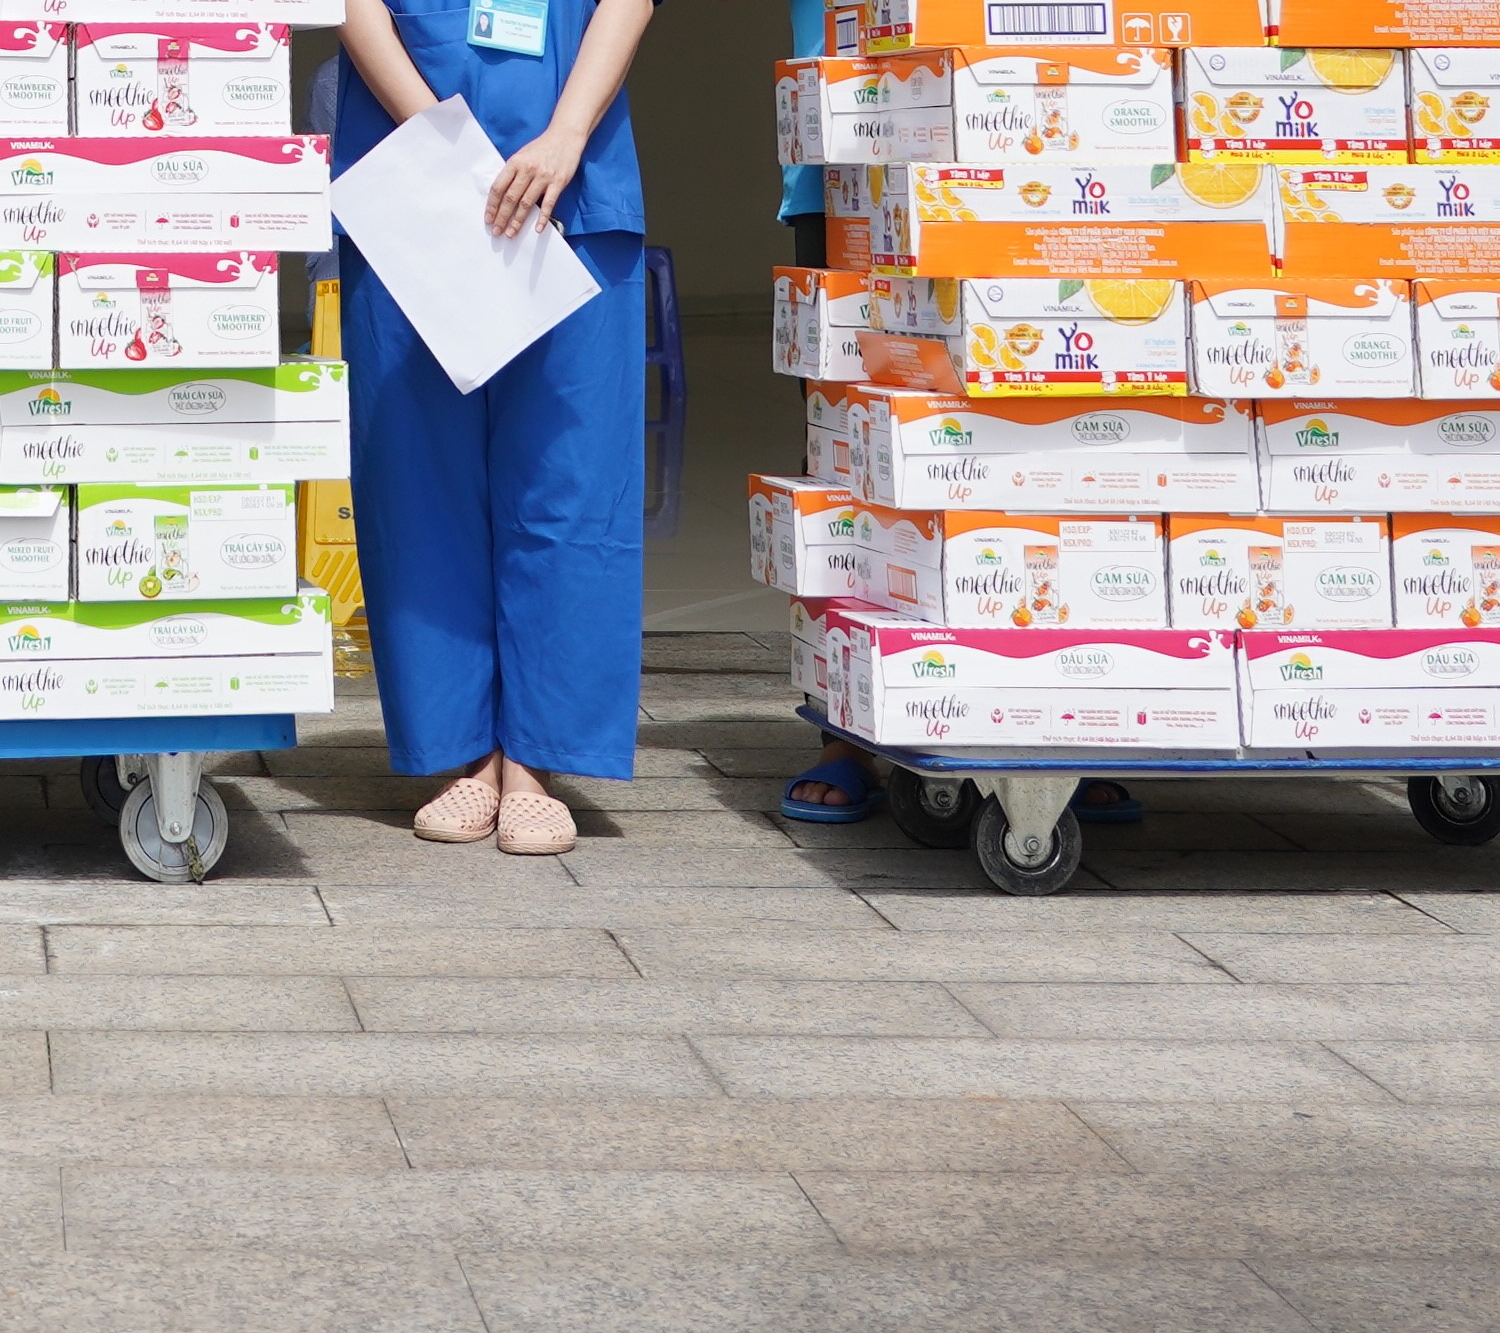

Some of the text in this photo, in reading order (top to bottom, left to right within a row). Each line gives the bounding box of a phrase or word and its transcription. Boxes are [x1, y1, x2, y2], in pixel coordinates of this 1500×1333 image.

[11, 170, 54, 186] Vfresh
[3, 197, 66, 223] smoothie
[11, 317, 32, 325] FRUIT
[1207, 338, 1275, 367] smoothie
[1353, 341, 1391, 350] ORANGE
[1350, 350, 1398, 361] SMOOTHIE
[1075, 422, 1099, 432] CAM
[929, 428, 973, 447] Vfresh
[927, 456, 990, 481] smoothie
[86, 539, 153, 565] smoothie
[1095, 572, 1122, 584] CAM
[8, 633, 51, 651] Vfresh
[2, 668, 65, 691] smoothie
[1280, 664, 1323, 681] Vfresh
[1274, 695, 1338, 720] smoothie
